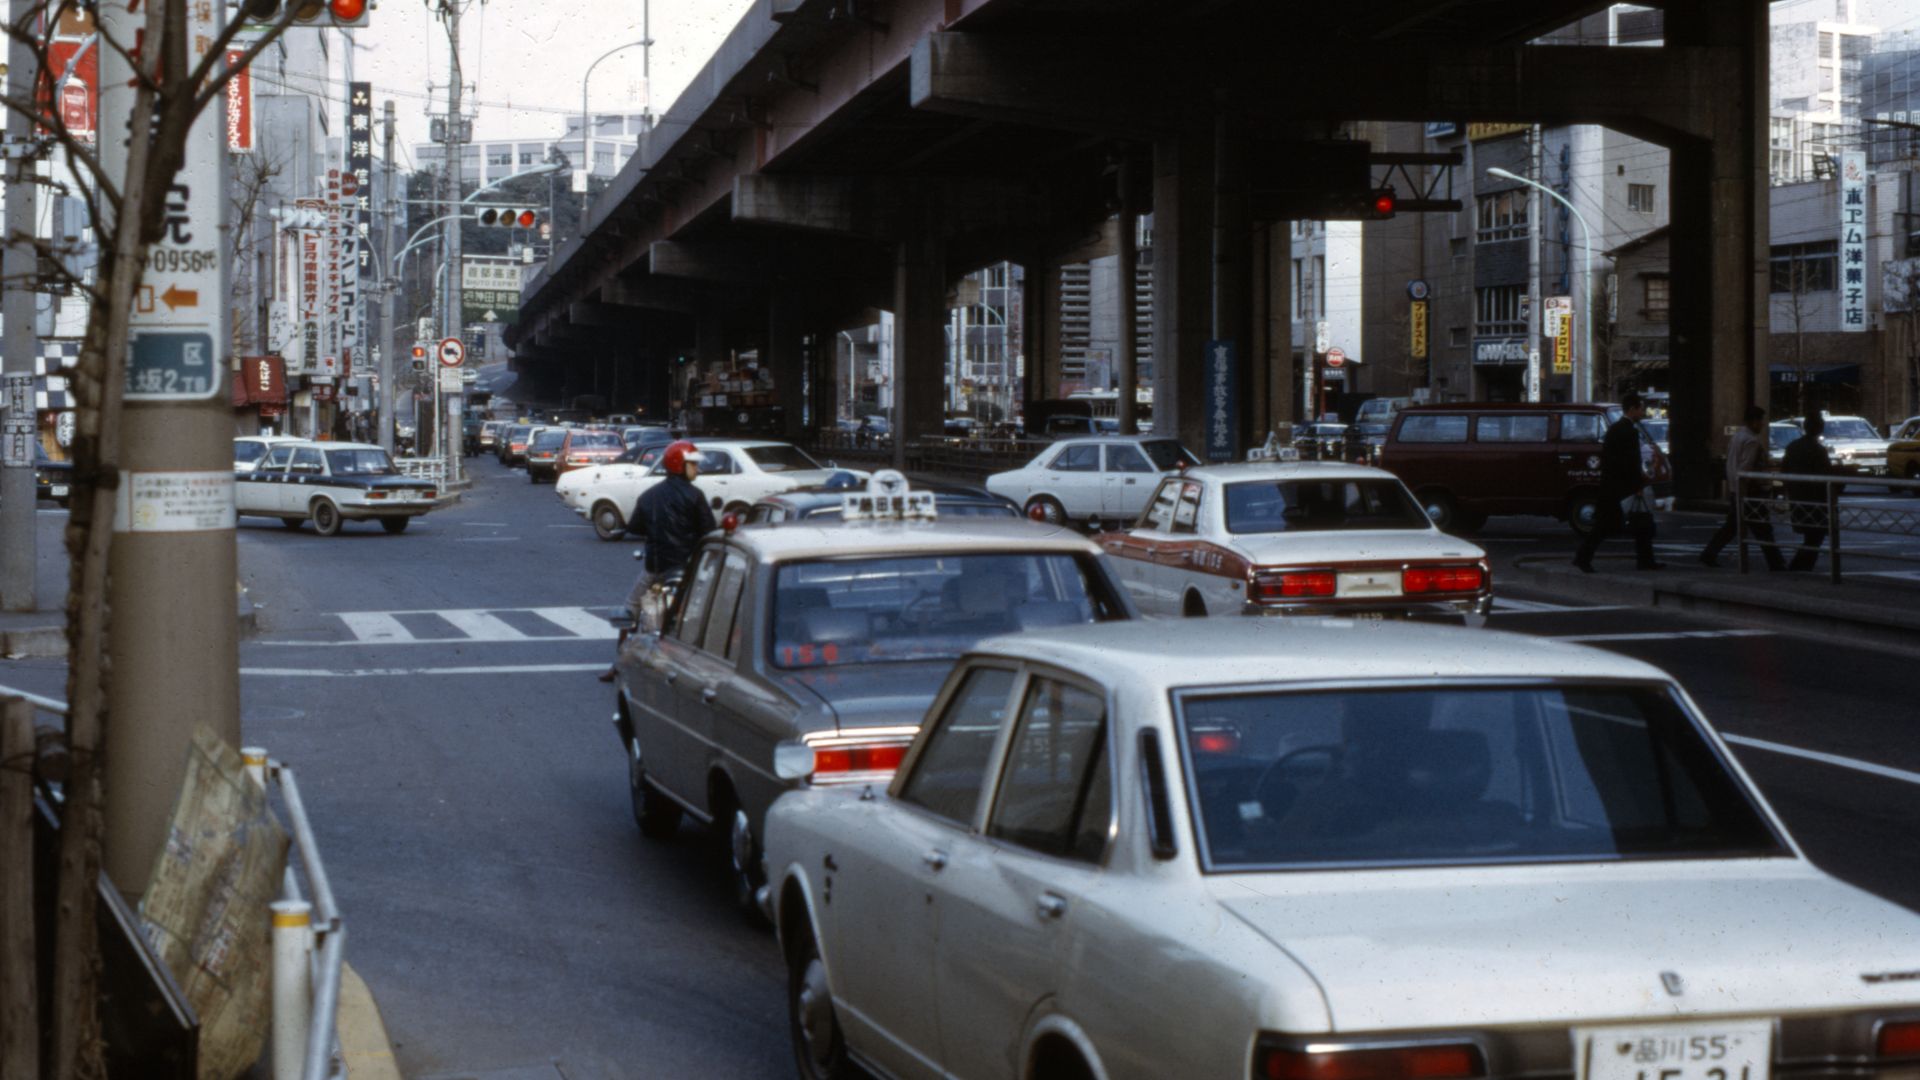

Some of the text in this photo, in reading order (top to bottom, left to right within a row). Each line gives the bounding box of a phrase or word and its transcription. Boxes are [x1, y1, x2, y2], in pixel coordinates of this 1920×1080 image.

[124, 368, 206, 394] 坂2丁目
[258, 359, 271, 392] たばこ
